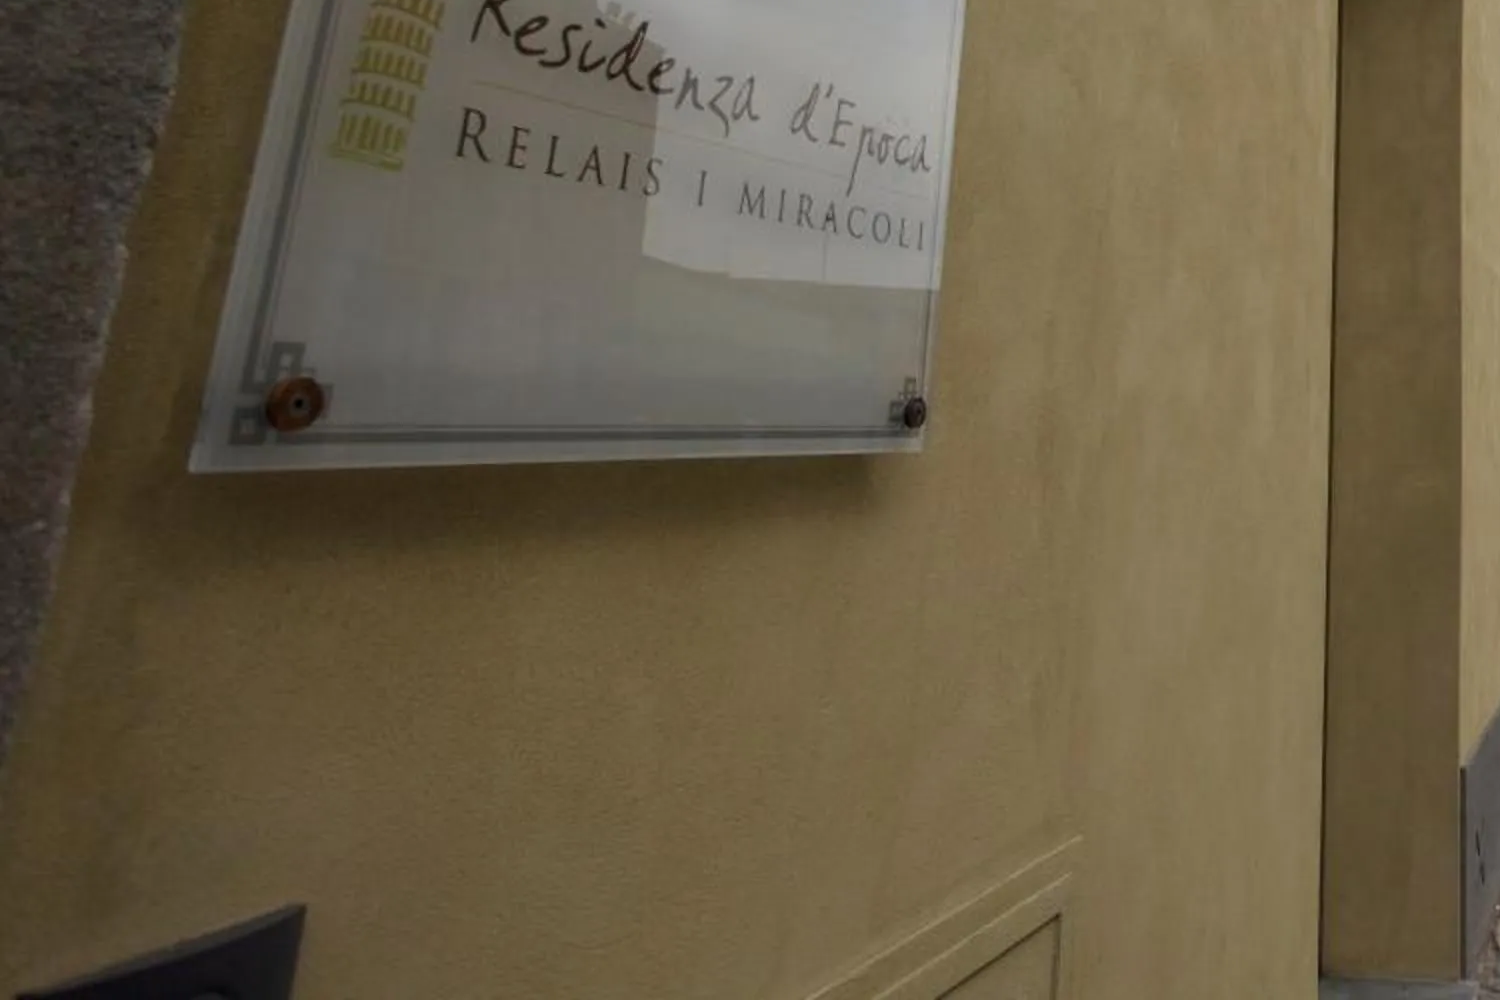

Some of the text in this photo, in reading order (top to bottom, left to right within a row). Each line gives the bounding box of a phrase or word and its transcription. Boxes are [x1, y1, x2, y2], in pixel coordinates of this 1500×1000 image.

[455, 106, 924, 251] RELAIS I MIRACOLI
[790, 83, 931, 198] d'Epoca
